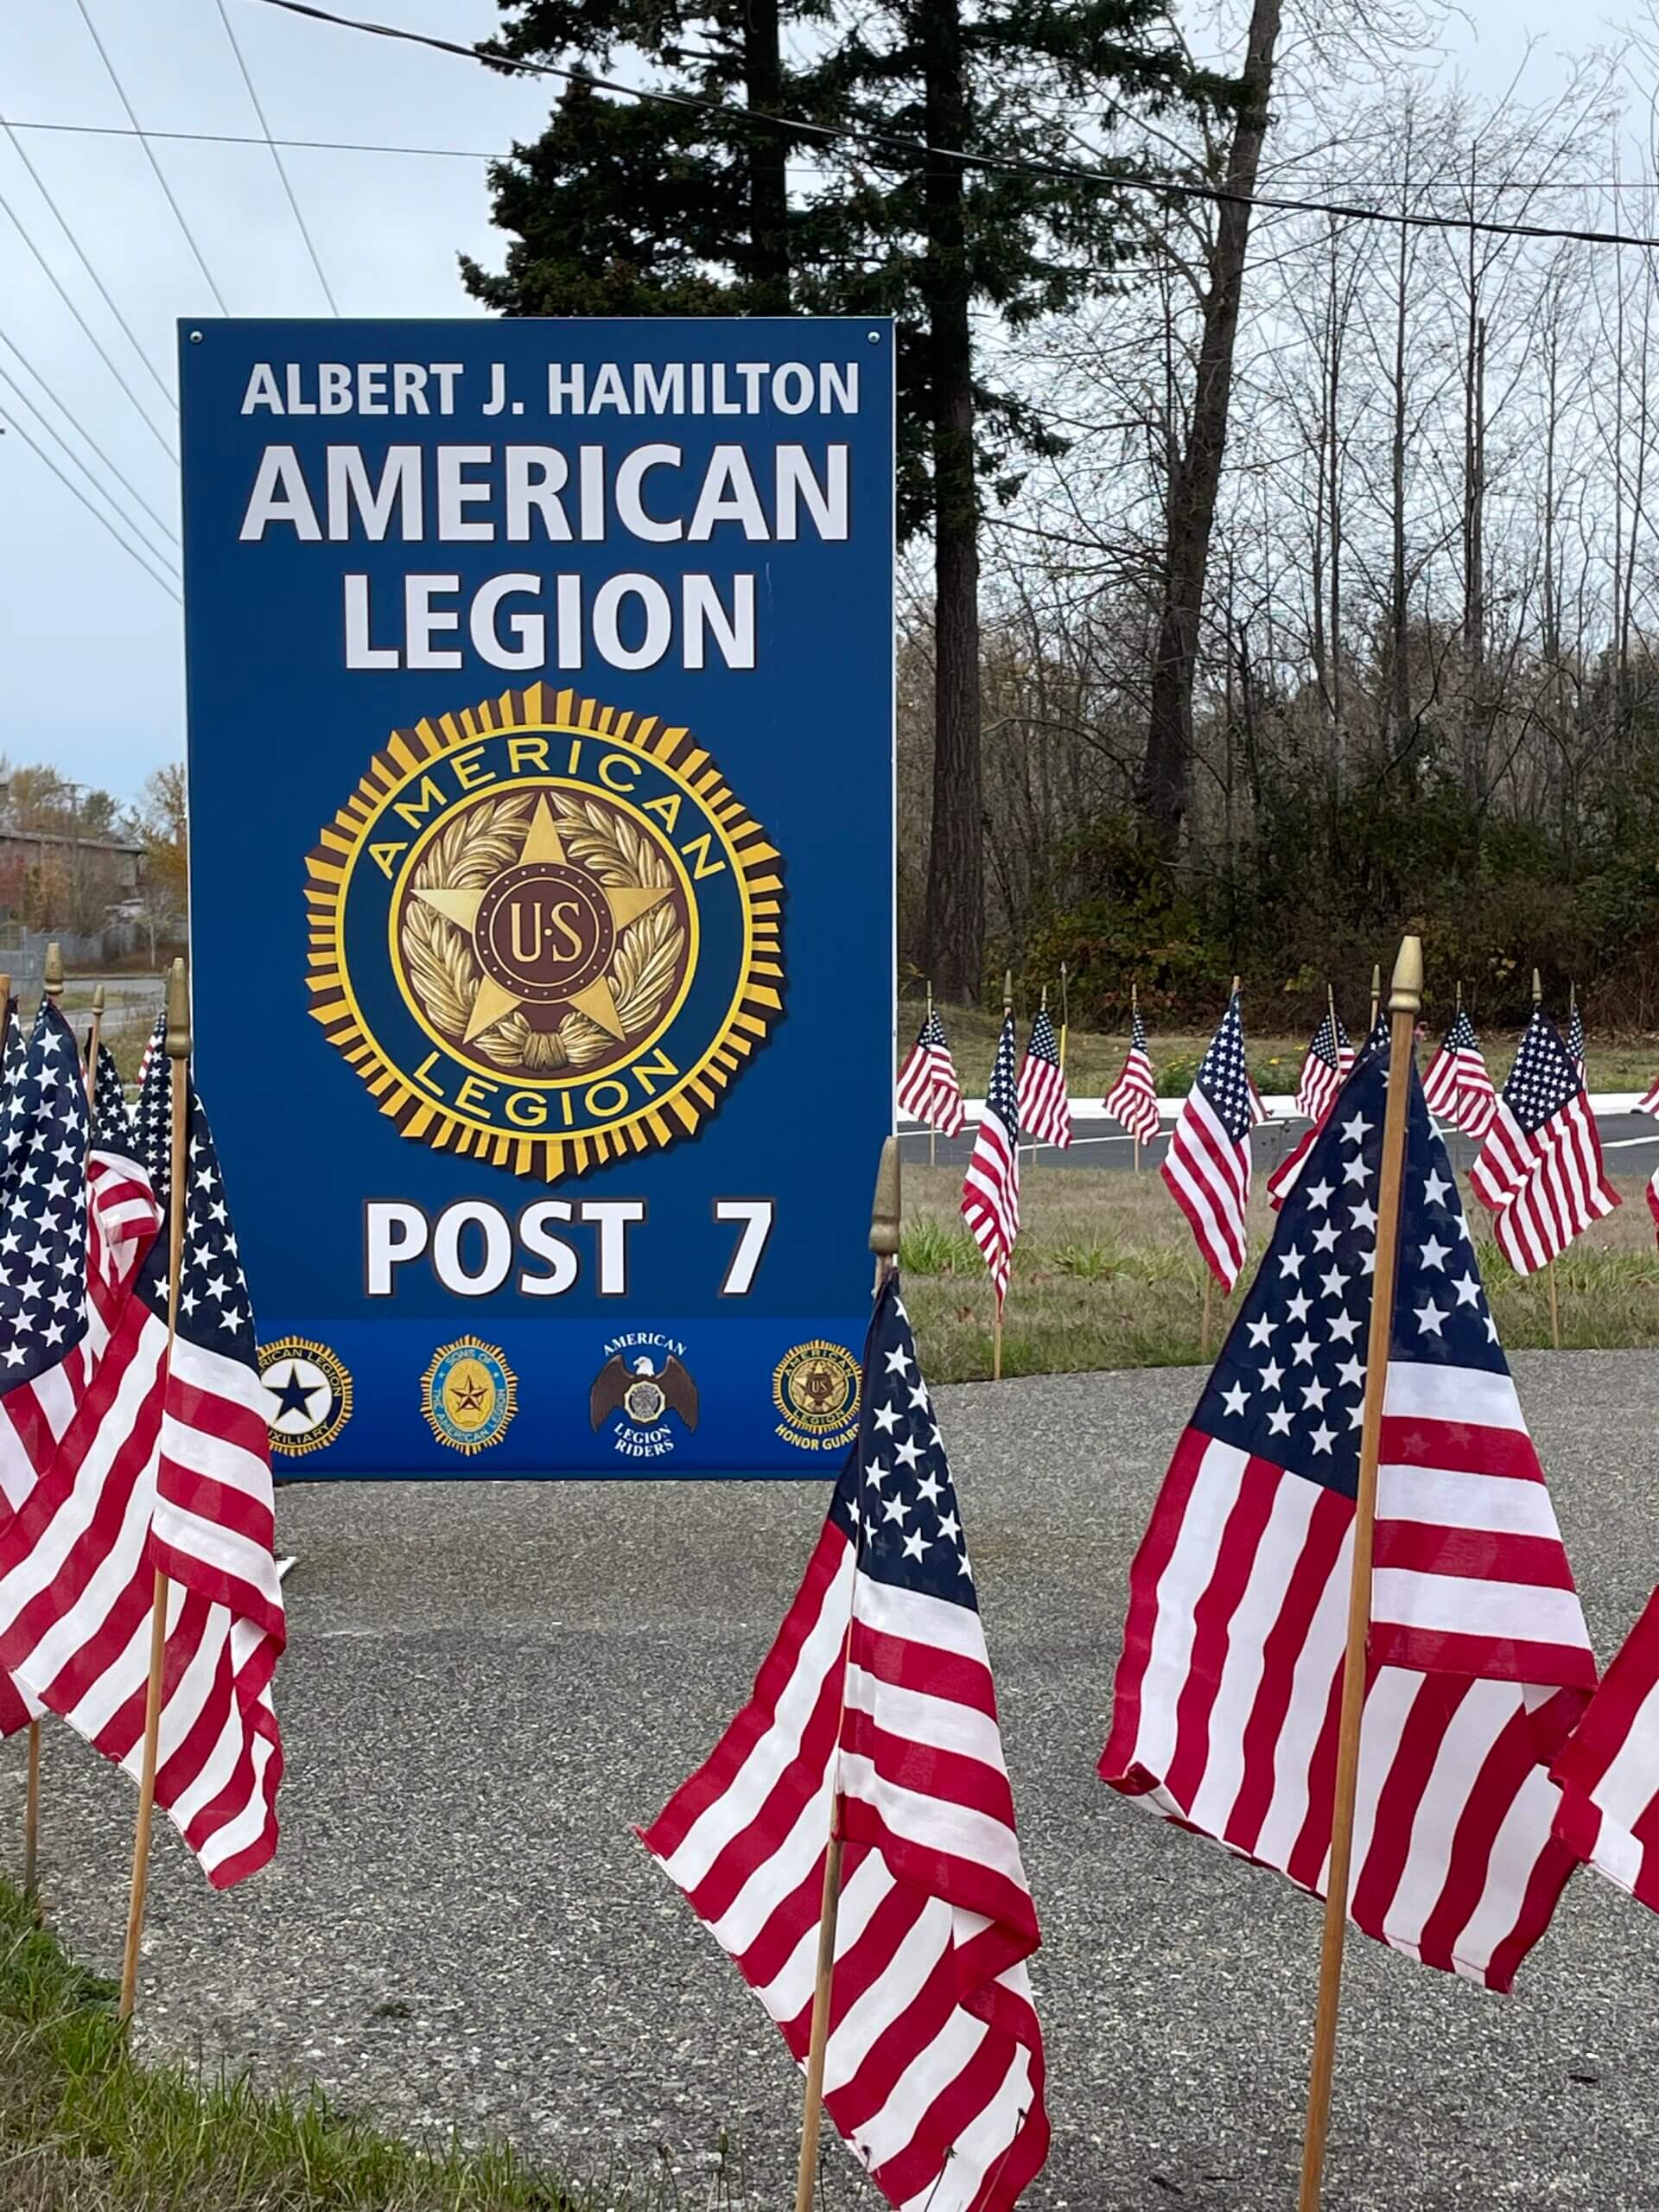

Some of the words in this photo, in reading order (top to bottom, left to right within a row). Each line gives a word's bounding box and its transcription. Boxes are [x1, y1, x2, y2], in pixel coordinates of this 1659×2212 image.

[241, 363, 463, 416] ALBERT
[482, 364, 524, 416] J.
[549, 362, 860, 415] HAMILTON
[239, 444, 849, 542] AMERICAN
[344, 573, 755, 671] LEGION
[368, 737, 726, 880] AMERICAN
[413, 1048, 679, 1127] LEGION
[366, 1200, 644, 1295] POST
[716, 1201, 773, 1294] 7
[444, 1349, 476, 1366] SONS
[603, 1332, 687, 1357] AMERICAN
[307, 1351, 343, 1397] LEGION
[784, 1349, 855, 1378] AMERICAN
[811, 1380, 828, 1394] US
[433, 1388, 444, 1411] THE
[487, 1389, 506, 1429] LEGION
[793, 1408, 845, 1425] LEGION
[613, 1421, 672, 1445] LEGION
[613, 1438, 675, 1458] RIDERS
[774, 1423, 820, 1451] HONOR
